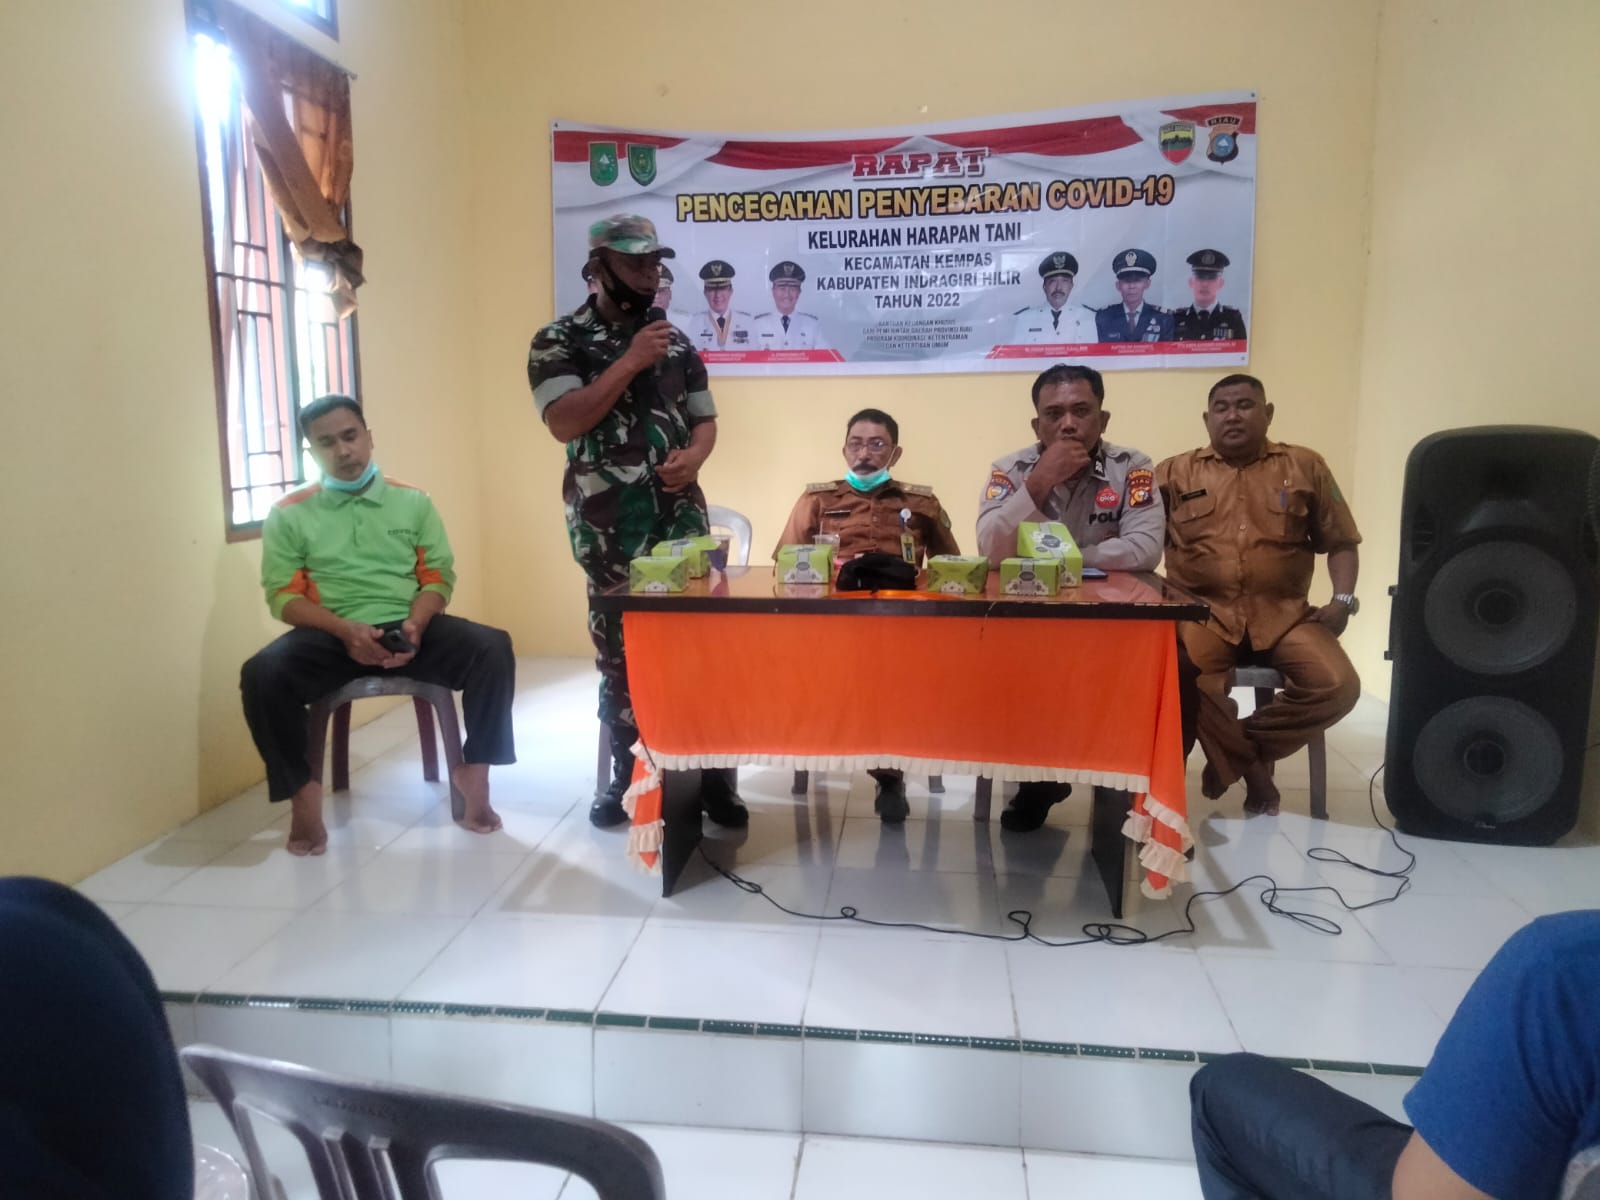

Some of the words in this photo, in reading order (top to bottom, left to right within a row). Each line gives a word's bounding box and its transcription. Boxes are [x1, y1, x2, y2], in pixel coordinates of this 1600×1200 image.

[852, 148, 989, 180] RAPAT
[676, 190, 853, 222] PENCEGAHAN
[858, 182, 1041, 218] PENYEBARAN
[1046, 174, 1176, 211] COVID-19
[808, 228, 901, 249] KELURAHAN
[907, 224, 980, 246] HARAPAN
[985, 222, 1021, 242] TANI
[844, 255, 930, 271] KECAMATAN
[935, 252, 993, 269] KEMPAS
[817, 275, 900, 291] KABUPATEN
[904, 272, 978, 289] INDRAGIRI
[982, 270, 1021, 286] HILIR
[874, 293, 922, 309] TAHUN
[927, 292, 960, 308] 2022
